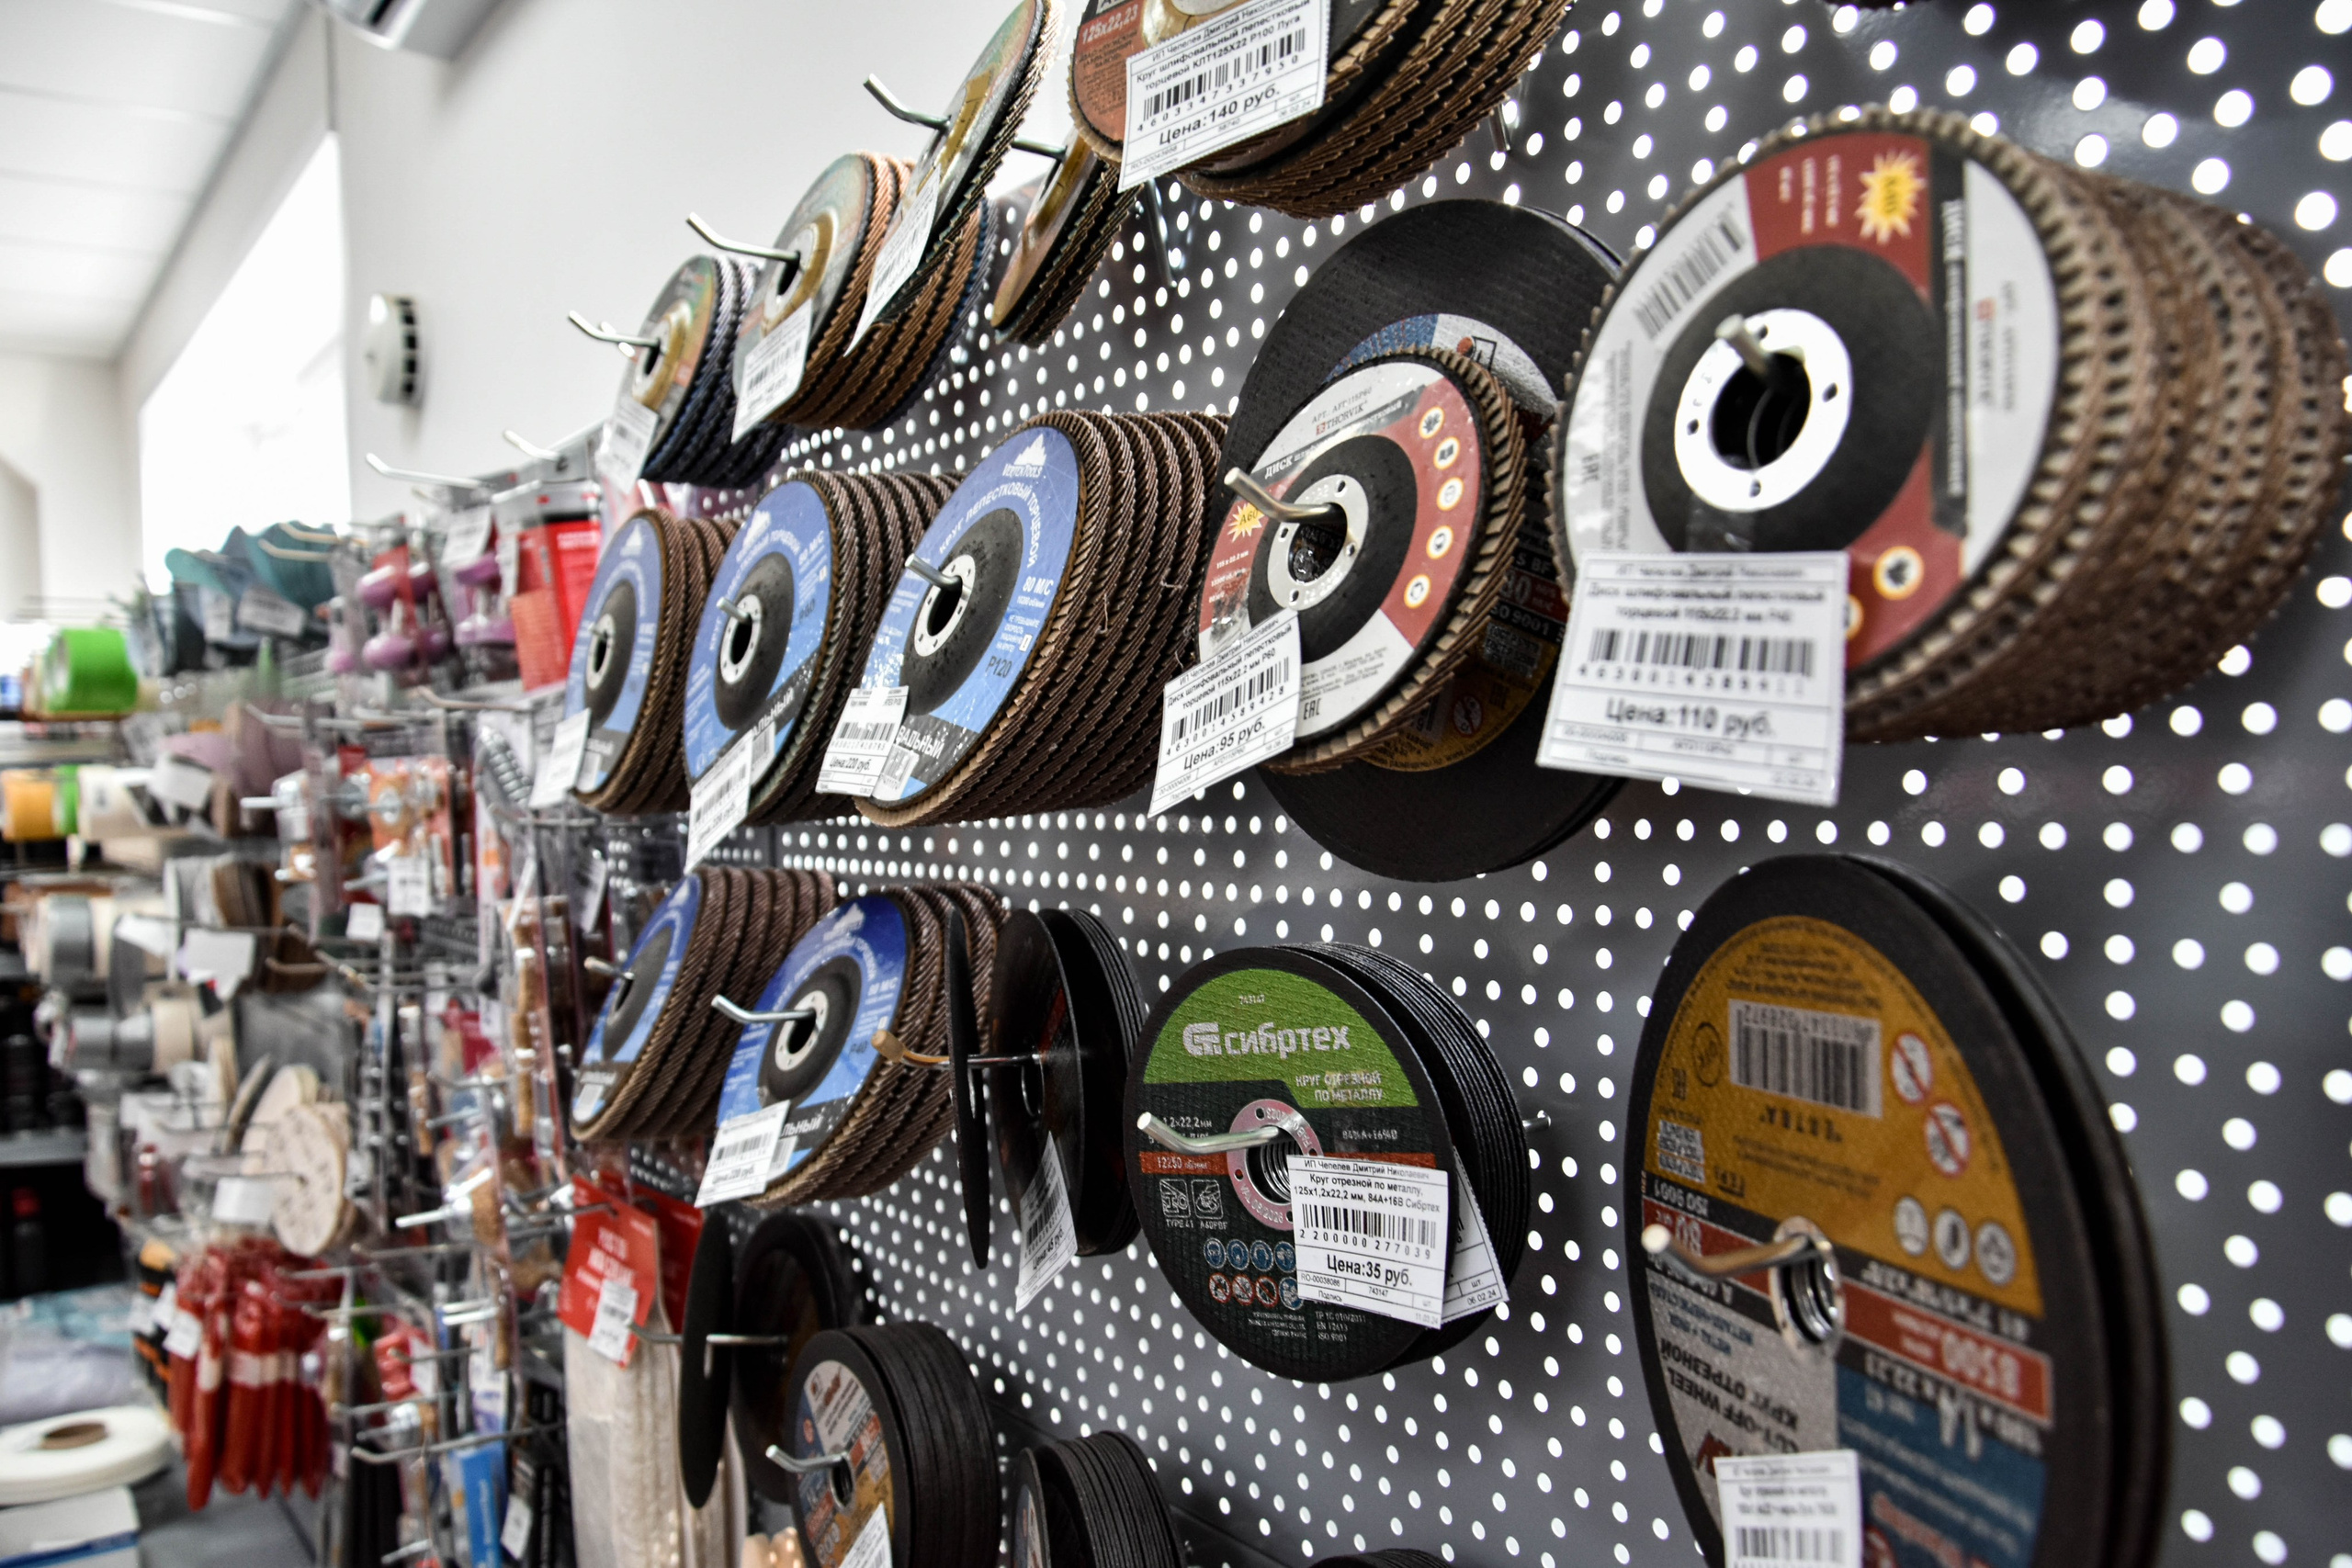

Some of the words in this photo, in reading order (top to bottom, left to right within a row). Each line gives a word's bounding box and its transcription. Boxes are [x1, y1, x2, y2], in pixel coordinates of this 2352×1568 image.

[1136, 65, 1158, 85] Круг
[1159, 30, 1240, 73] шлифовальный
[1241, 0, 1310, 38] лепестковый
[1152, 50, 1165, 62] ИП
[1203, 13, 1241, 42] Дмитрий
[1144, 65, 1191, 91] торцевой
[1276, 15, 1301, 33] Луга
[1159, 100, 1238, 146] Цена:140
[1243, 84, 1281, 112] руб.
[1326, 405, 1364, 430] THORVIK
[1264, 454, 1294, 479] ДИСК
[939, 517, 965, 555] КРУГ
[965, 481, 1034, 524] ЛЕПЕСТКОВЫЙ
[1026, 492, 1042, 569] ТОРЦЕВОЙ
[1243, 619, 1280, 645] Николаевич
[986, 656, 1013, 678] P120
[1168, 691, 1185, 709] Диск
[1187, 660, 1243, 697] шлифовальный
[1243, 626, 1293, 663] лепестковый
[1182, 684, 1216, 710] торцевой
[1249, 659, 1261, 671] мм
[1606, 698, 1718, 730] Цена:110
[1724, 710, 1774, 742] руб.
[897, 725, 945, 760] ВАЛЬНЫЙ
[1183, 736, 1236, 771] Цена:95
[1238, 716, 1266, 745] руб.
[857, 759, 872, 773] руб.
[1225, 1022, 1351, 1059] сибртех
[1295, 1074, 1321, 1087] КРУГ
[1324, 1070, 1383, 1086] ОТРЕЗНОЙ
[1314, 1089, 1332, 1101] ПО
[1333, 1088, 1385, 1102] МЕТАЛЛУ
[1157, 1156, 1182, 1169] 12250
[1304, 1159, 1317, 1168] ИП
[1318, 1160, 1351, 1172] Чепелев
[1352, 1165, 1385, 1177] Дмитрий
[1386, 1168, 1430, 1180] Николаевич
[1309, 1173, 1330, 1187] Круг
[1331, 1177, 1373, 1190] отрезной
[1374, 1180, 1385, 1190] по
[1387, 1182, 1424, 1197] металлу,
[1654, 1179, 1684, 1207] 9001
[1351, 1192, 1366, 1203] мм,
[1406, 1197, 1441, 1213] Сибртех
[1327, 1254, 1382, 1280] Цена:35
[1385, 1269, 1413, 1287] руб.
[1471, 1278, 1485, 1288] шт.
[1318, 1290, 1343, 1303] Подпись
[1369, 1286, 1389, 1297] 743147
[1317, 1321, 1326, 1331] EN
[1317, 1332, 1329, 1341] ISO
[1660, 1338, 1747, 1402] ОТРЕЗНОЙ
[1667, 1367, 1721, 1414] WHEEL
